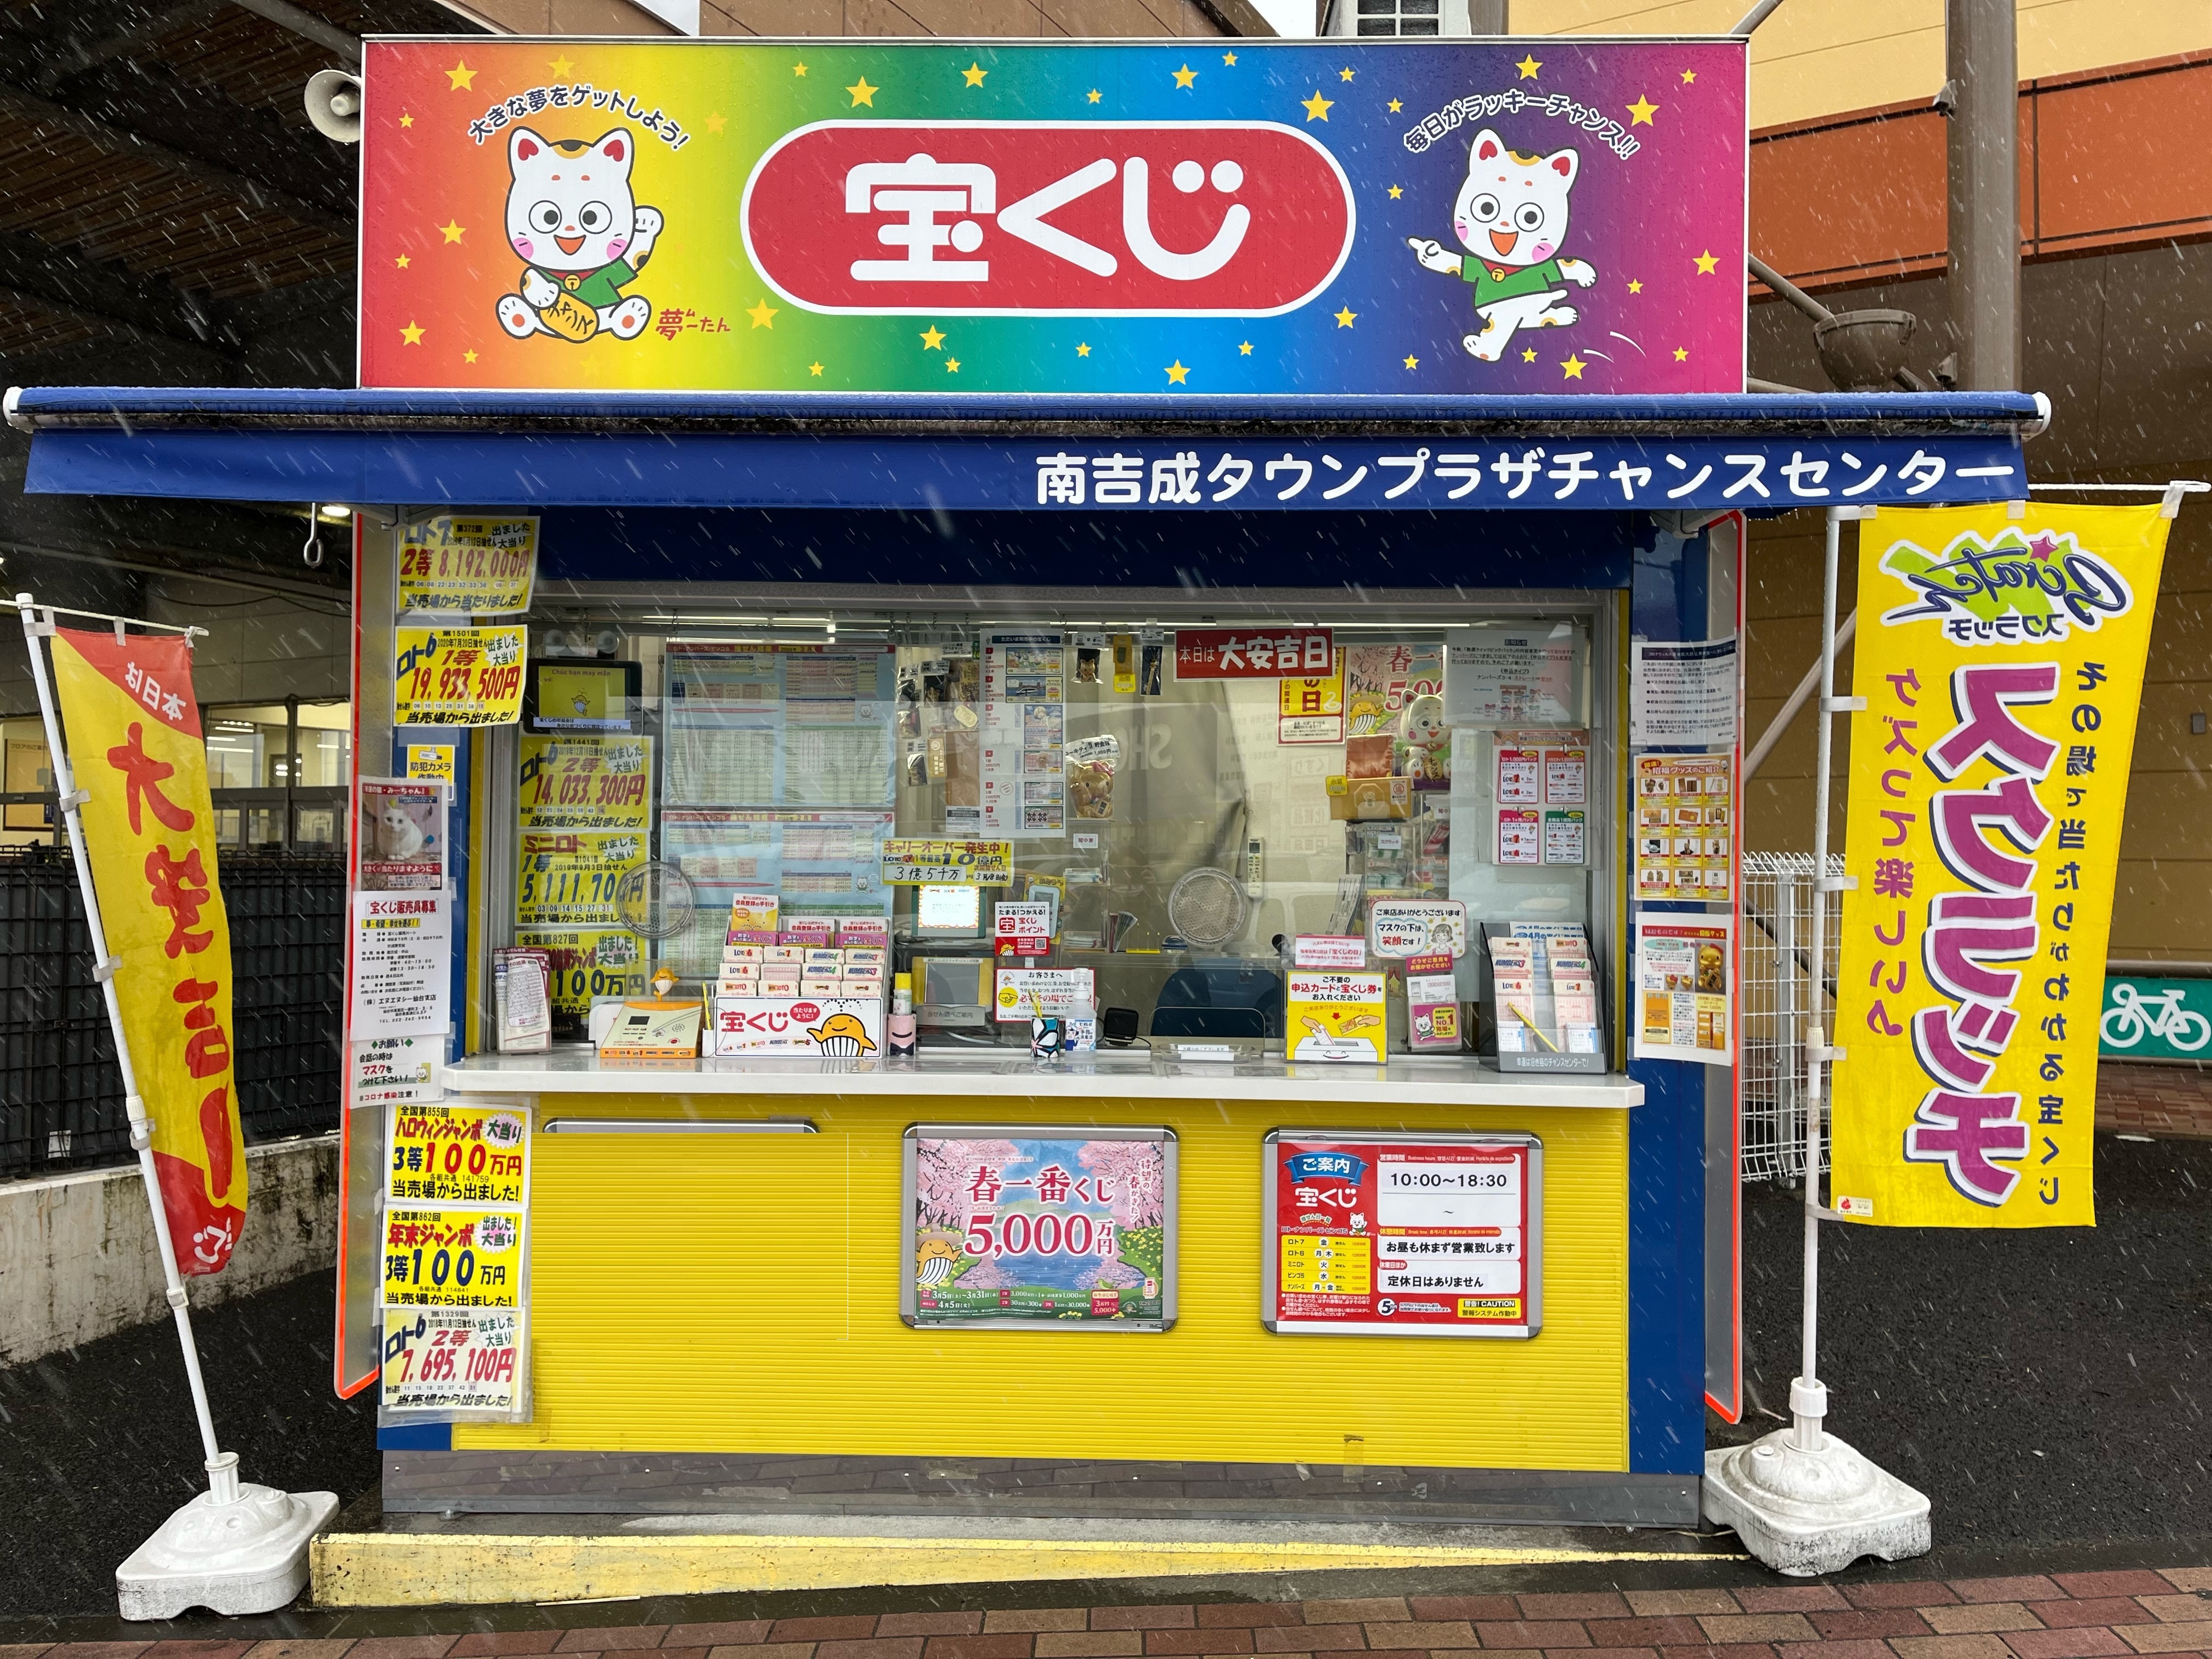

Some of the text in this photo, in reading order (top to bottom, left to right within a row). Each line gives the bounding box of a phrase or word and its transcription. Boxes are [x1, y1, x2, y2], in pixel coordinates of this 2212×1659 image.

[468, 85, 691, 149] 大きな夢をゲットしよう!
[1405, 89, 1639, 159] 毎日がラッキーチャンス!!
[845, 153, 1251, 281] 宝くじ
[1036, 447, 2015, 506] 南吉成タウンプラザチャンスセンター
[498, 536, 526, 549] 大当り
[487, 634, 519, 652] 出ました
[441, 650, 516, 667] 1等 大当り
[1218, 635, 1328, 670] 大安吉日
[410, 665, 521, 701] 19,933,500円
[405, 711, 515, 724] 当売場から出ました!
[608, 746, 644, 761] 出ました
[410, 762, 452, 772] 防犯カメラ
[562, 757, 640, 774] 2等 大当り
[533, 774, 646, 806] 14,033,300円
[528, 816, 644, 827] 当売場から出ました!
[524, 834, 639, 854] ミニロト 出ました
[884, 841, 1009, 854] キャリーオーバー発生中!
[605, 850, 635, 863] 大当り
[894, 866, 960, 881] 3億5千万
[370, 900, 437, 915] 宝くじ販売員募集
[1376, 909, 1461, 917] ご来店ありがとうございます
[1378, 924, 1425, 932] マスクの下は、
[522, 934, 579, 945] 全国第827回
[1382, 936, 1421, 946] 笑顔です!
[1291, 984, 1382, 994] 申込カードと宝くじ券を
[720, 1011, 789, 1032] 宝くじ
[379, 1039, 404, 1049] お願い
[359, 1052, 393, 1063] 会話の時は
[362, 1064, 393, 1075] マスクを
[400, 1106, 450, 1118] 全国第855回
[395, 1116, 522, 1144] ハロウィンジャンボ 大当り
[1302, 1156, 1350, 1173] ご案内
[392, 1179, 519, 1201] 当売場から出ました!
[965, 1166, 1115, 1203] 春一番くじ
[1295, 1187, 1358, 1208] 宝くじ
[392, 1211, 441, 1222] 全国第862回
[387, 1223, 517, 1248] 年末ジャンボ 大当り
[1386, 1242, 1515, 1254] お昼も休まず営業致します
[1387, 1276, 1484, 1287] 定休日はありません
[386, 1292, 512, 1306] 当売場から出ました!
[478, 1316, 515, 1333] 出ました
[431, 1330, 511, 1347] 2等 大当り
[400, 1347, 517, 1383] 7,695,100円
